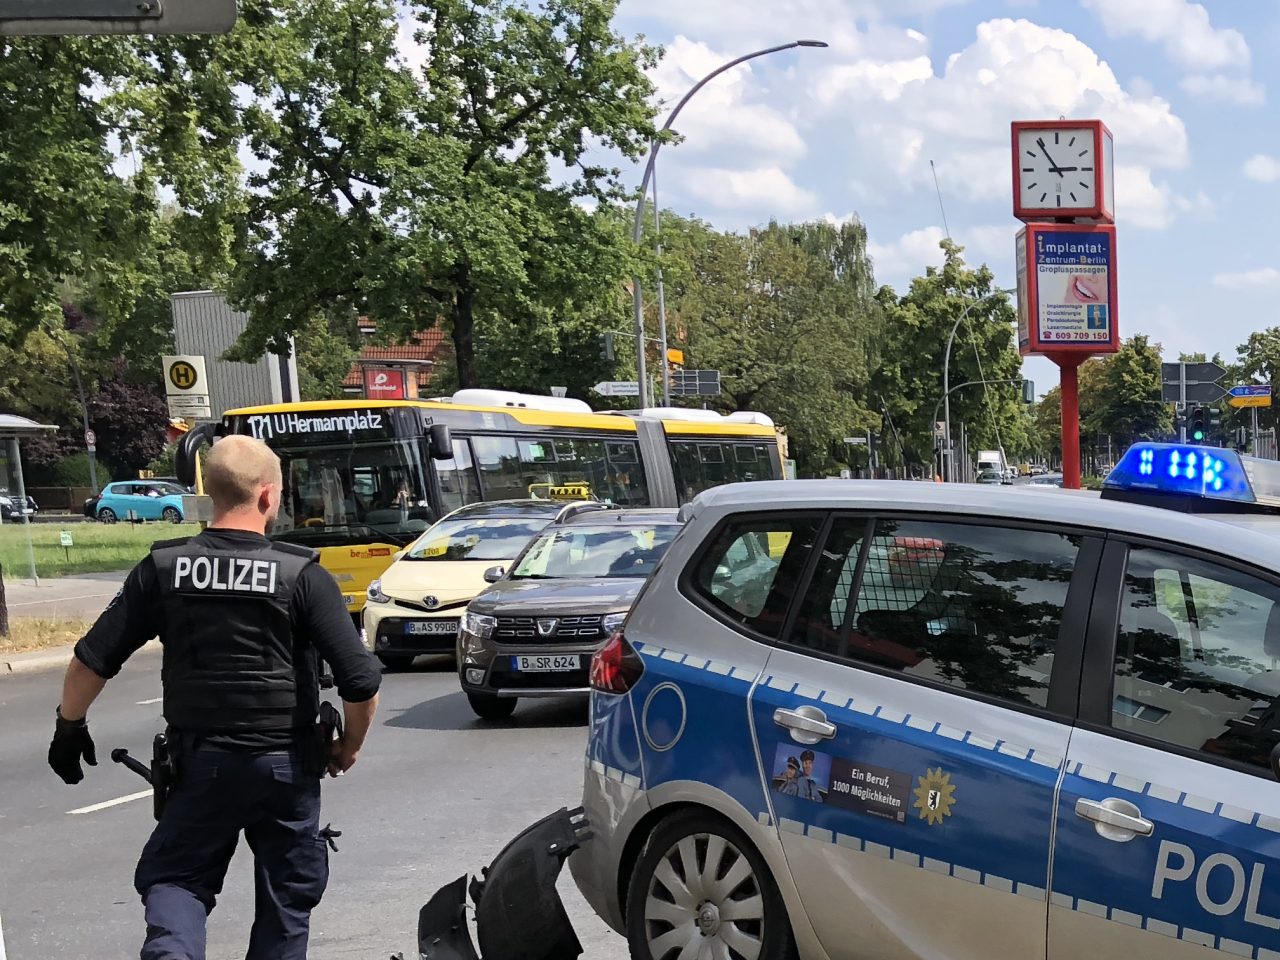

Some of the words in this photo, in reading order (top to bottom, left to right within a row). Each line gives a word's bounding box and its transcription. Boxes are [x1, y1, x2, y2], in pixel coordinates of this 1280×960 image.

[1039, 254, 1107, 264] Zentrum-Berlin
[1055, 332, 1071, 340] 609
[1073, 332, 1089, 340] 709
[1092, 332, 1108, 340] 150
[175, 367, 190, 383] H
[247, 414, 273, 439] 171
[274, 414, 286, 434] U
[287, 409, 383, 434] Hermannplatz
[174, 556, 277, 593] POLIZEI
[410, 623, 416, 632] B
[421, 622, 433, 632] AS
[435, 622, 457, 632] 9908
[522, 657, 530, 668] B
[536, 657, 550, 668] SR
[553, 656, 575, 667] 624
[851, 768, 865, 782] Ein
[866, 773, 890, 788] Beruf,
[832, 780, 850, 794] 1000
[850, 785, 901, 807] Möglichkeiten
